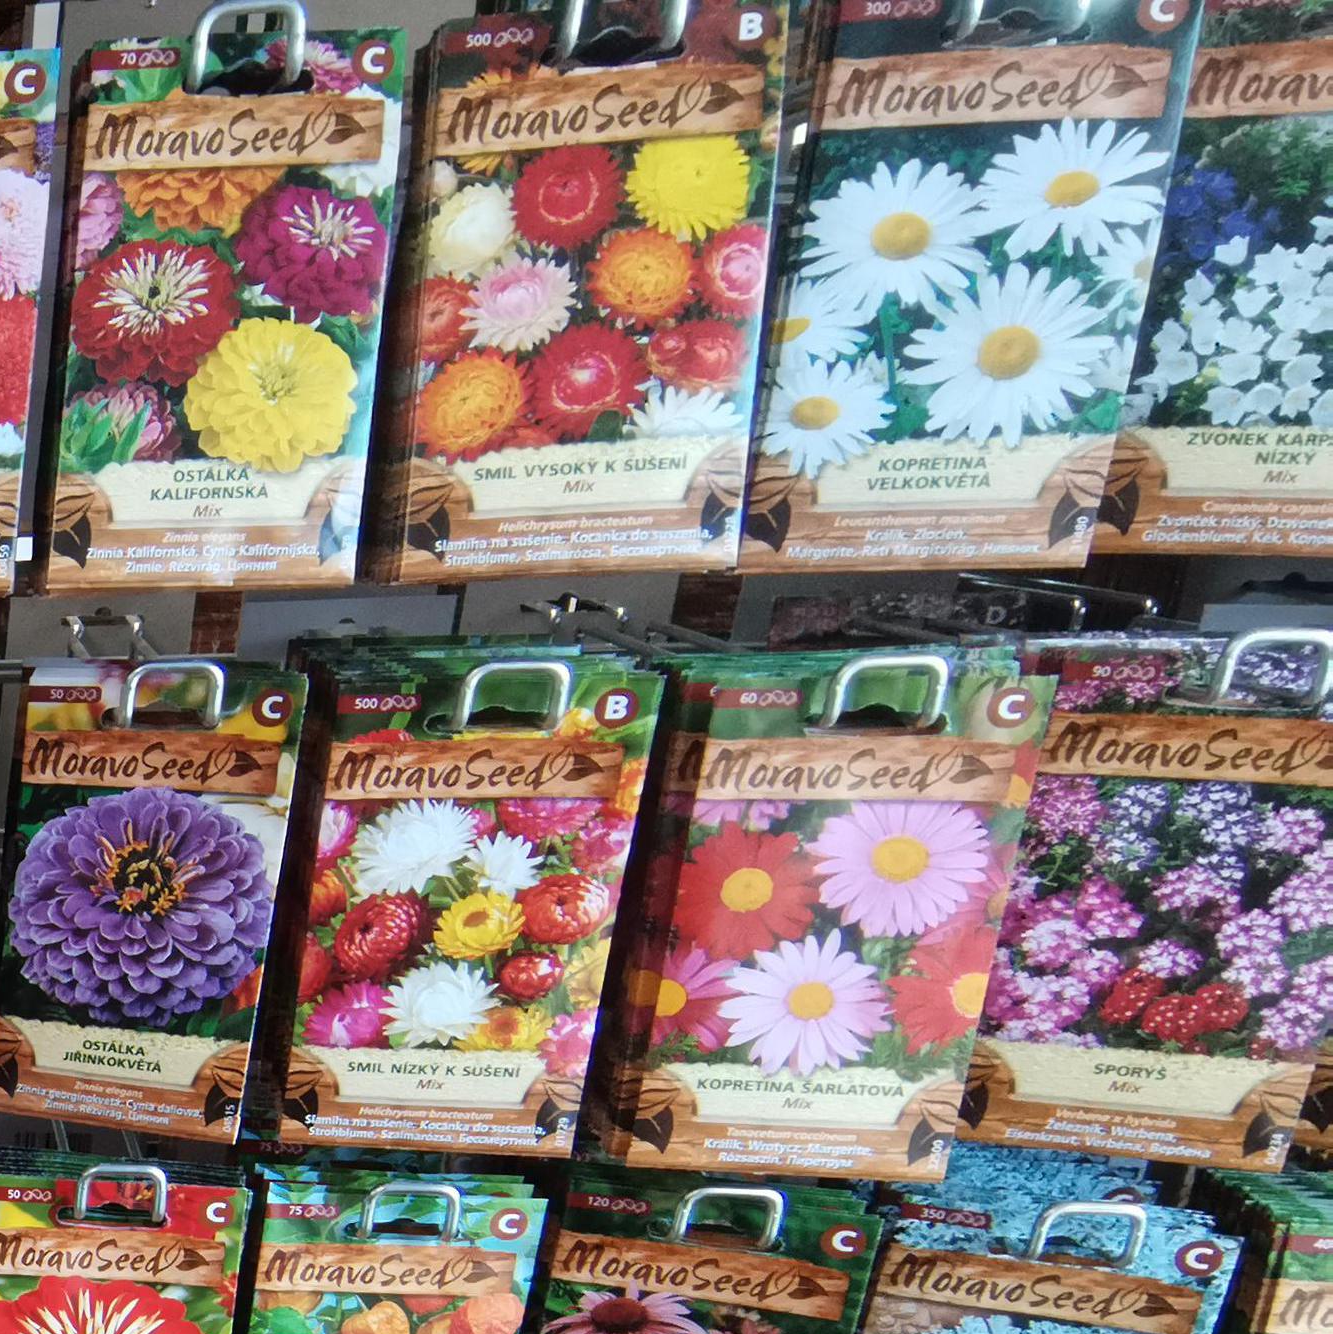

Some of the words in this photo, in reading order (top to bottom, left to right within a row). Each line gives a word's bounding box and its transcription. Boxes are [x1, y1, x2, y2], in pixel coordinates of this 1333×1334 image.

[835, 56, 1093, 118] MoravoSeed
[448, 83, 695, 143] MoravoSeed
[96, 108, 315, 163] MoravoSeed
[1187, 432, 1271, 447] ZVONEK
[474, 465, 517, 481] SMIL
[524, 459, 598, 478] VYSOKÝ
[603, 460, 620, 475] K
[625, 454, 689, 473] SUŠENÍ
[878, 456, 987, 472] KOPRETINA
[1255, 450, 1317, 466] NÍZKÝ
[174, 465, 250, 483] OSTÁLKA
[867, 471, 991, 491] VELKOKVĚTÁ
[1263, 469, 1298, 484] Mix
[150, 482, 269, 502] KALIFORNSKÁ
[563, 479, 595, 495] Mix
[193, 503, 222, 518] Mix
[30, 737, 225, 783] MoravoSeed
[1049, 726, 1299, 777] MoravoSeed
[334, 743, 559, 791] MoravoSeed
[704, 747, 939, 794] MoravoSeed
[82, 1038, 147, 1057] OSTÁLKA
[62, 1050, 163, 1074] JIŘINKOKVĚTÁ
[347, 1060, 385, 1075] SMIL
[389, 1058, 441, 1077] NÍZKÝ
[445, 1062, 459, 1077] K
[463, 1061, 523, 1079] SUŠENÍ
[416, 1077, 446, 1091] Mix
[696, 1076, 795, 1095] KOPRETINA
[800, 1076, 906, 1099] ŠARLATOVÁ
[1107, 1079, 1141, 1097] Mix
[781, 1096, 814, 1113] Mix
[265, 1248, 461, 1291] MoravoSeed
[563, 1240, 783, 1302] MoravoSeed
[890, 1254, 1127, 1318] MoravoSeed
